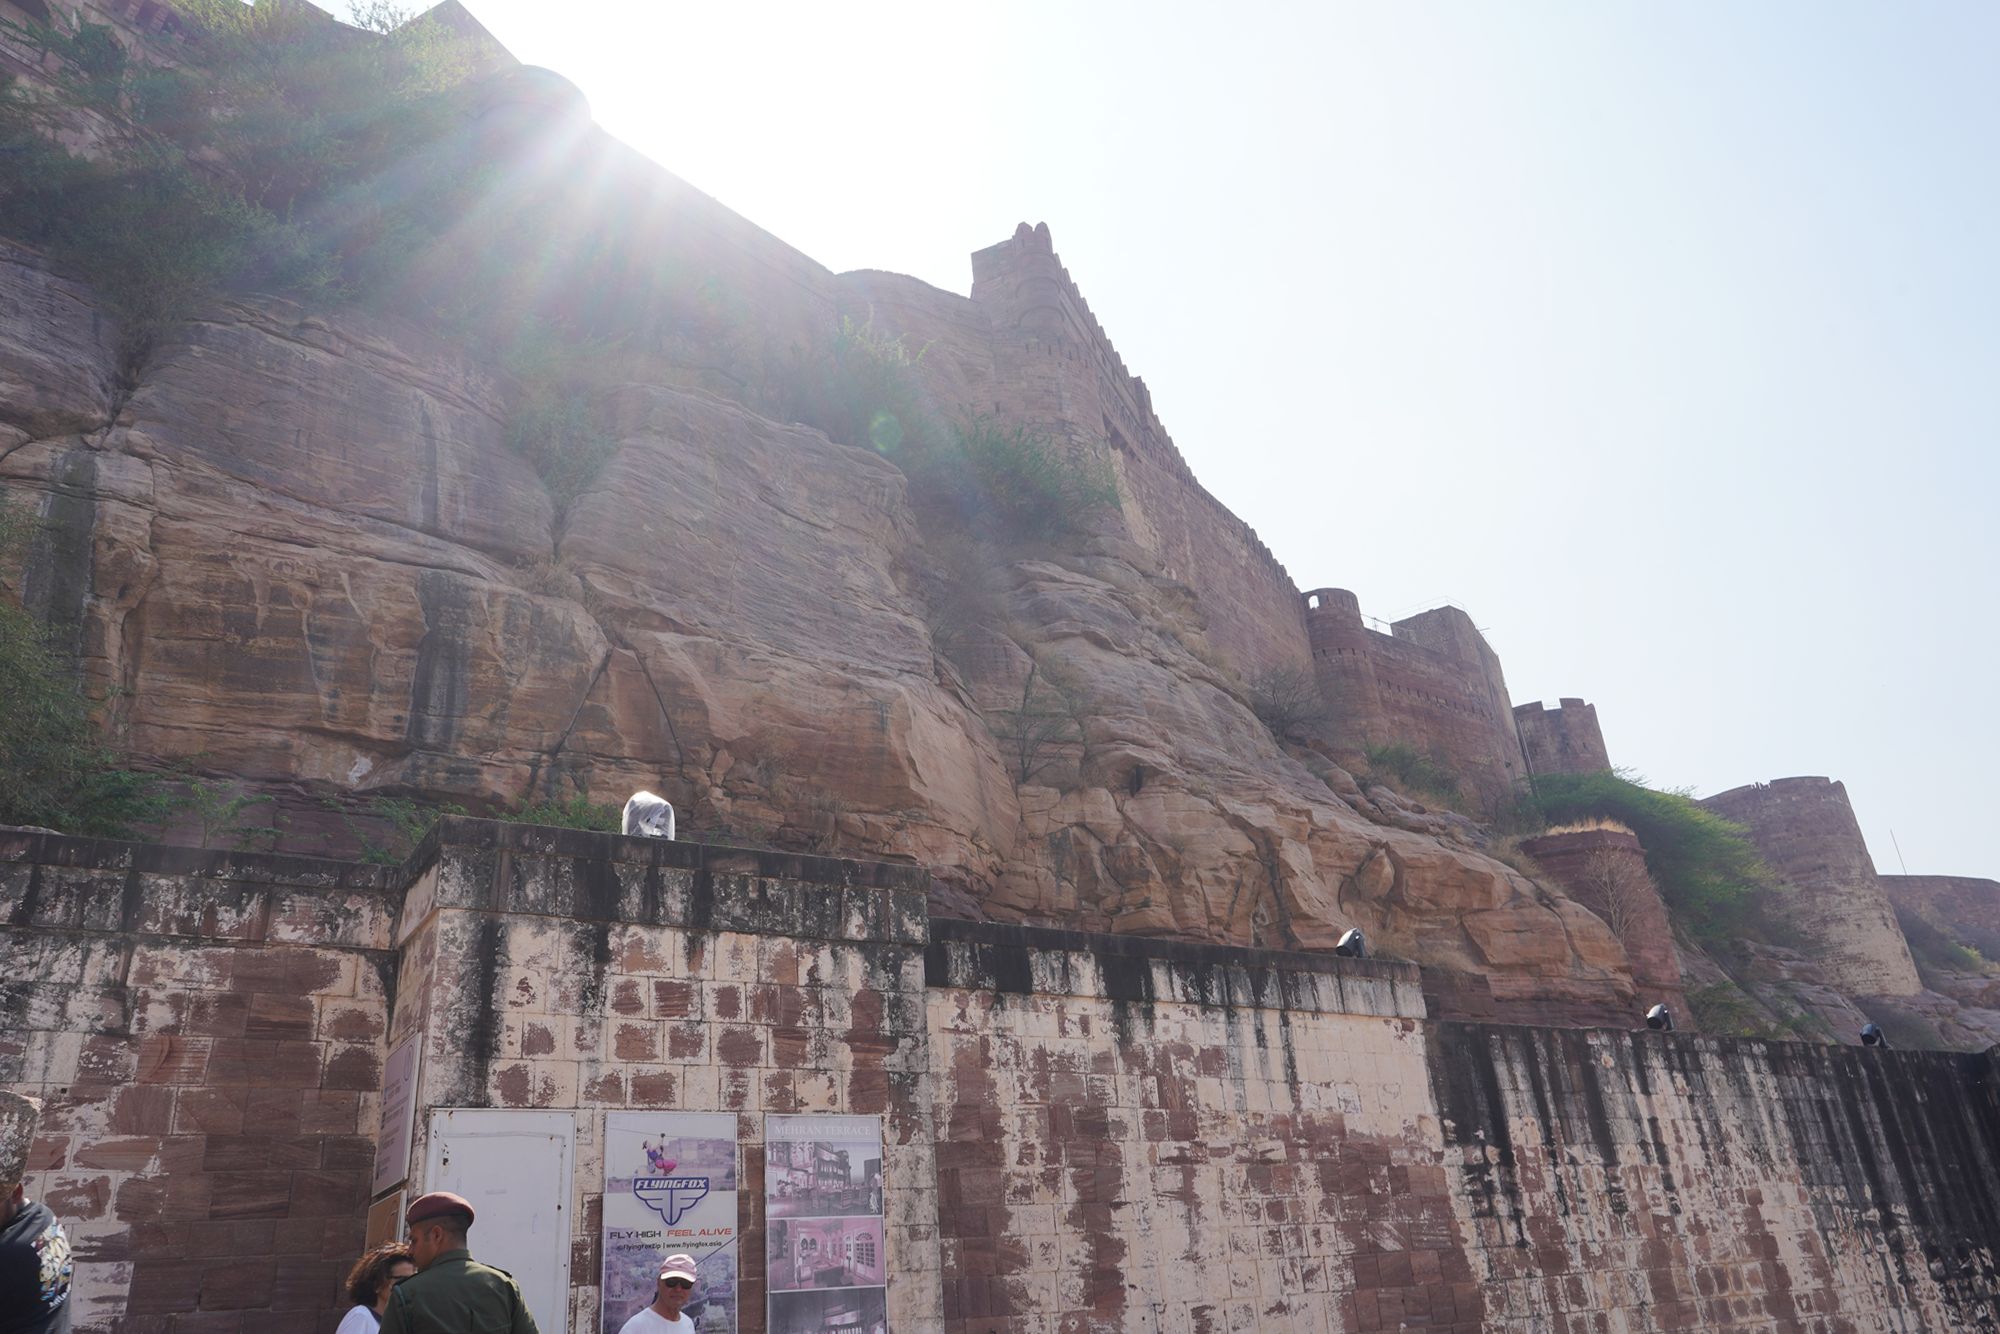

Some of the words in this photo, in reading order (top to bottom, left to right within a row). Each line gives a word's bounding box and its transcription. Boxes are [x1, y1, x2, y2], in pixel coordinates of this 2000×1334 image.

[775, 1126, 820, 1136] MEHRAN
[825, 1126, 871, 1136] TERRACE
[635, 1179, 706, 1189] FLYINGFOX
[609, 1231, 634, 1239] FLY
[666, 1229, 696, 1237] FEEL
[699, 1228, 732, 1236] ALIVE
[666, 1241, 722, 1249] www.flyingfox.asia
